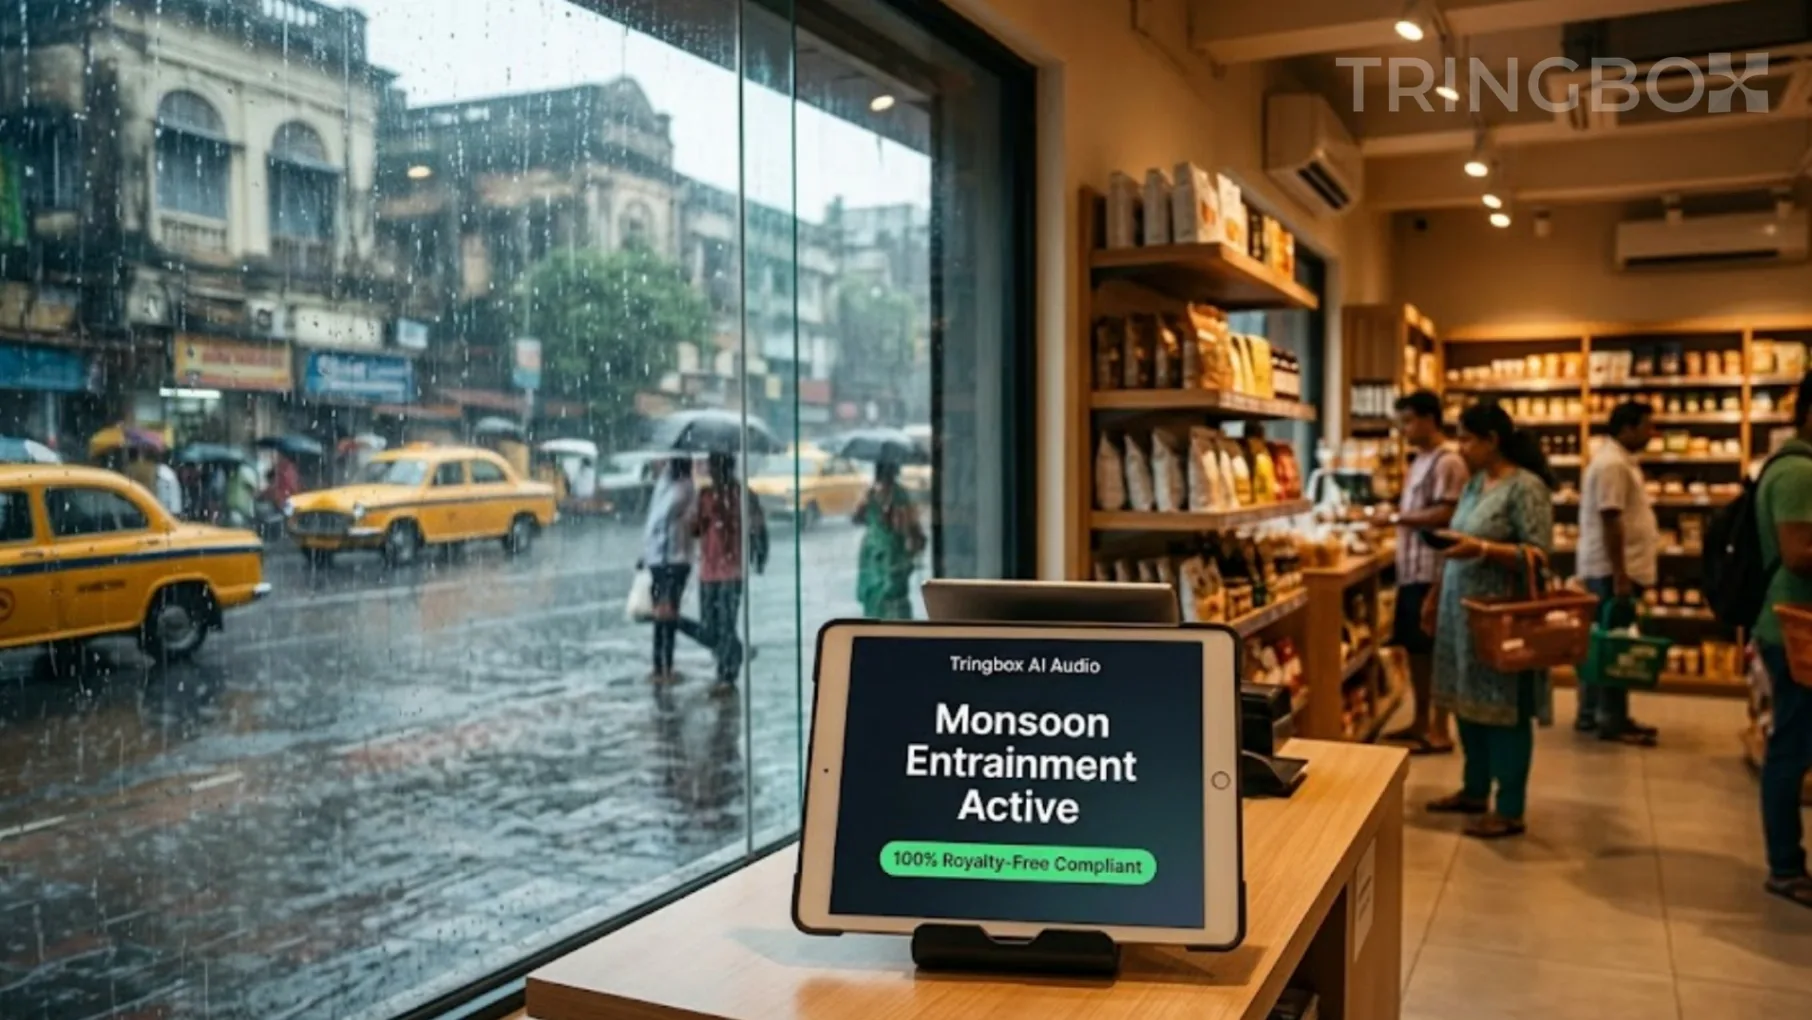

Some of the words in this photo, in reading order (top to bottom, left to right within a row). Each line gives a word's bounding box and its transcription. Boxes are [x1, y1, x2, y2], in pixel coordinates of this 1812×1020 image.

[950, 655, 1024, 675] Tringbox
[1028, 657, 1046, 672] AI
[1050, 657, 1101, 674] Audio
[935, 703, 1110, 738] Monsoon
[906, 744, 1137, 782] Entrainment
[957, 788, 1080, 824] Active
[893, 851, 938, 868] 100%
[943, 852, 1049, 873] Royalty-Free
[1054, 856, 1142, 876] Compliant
